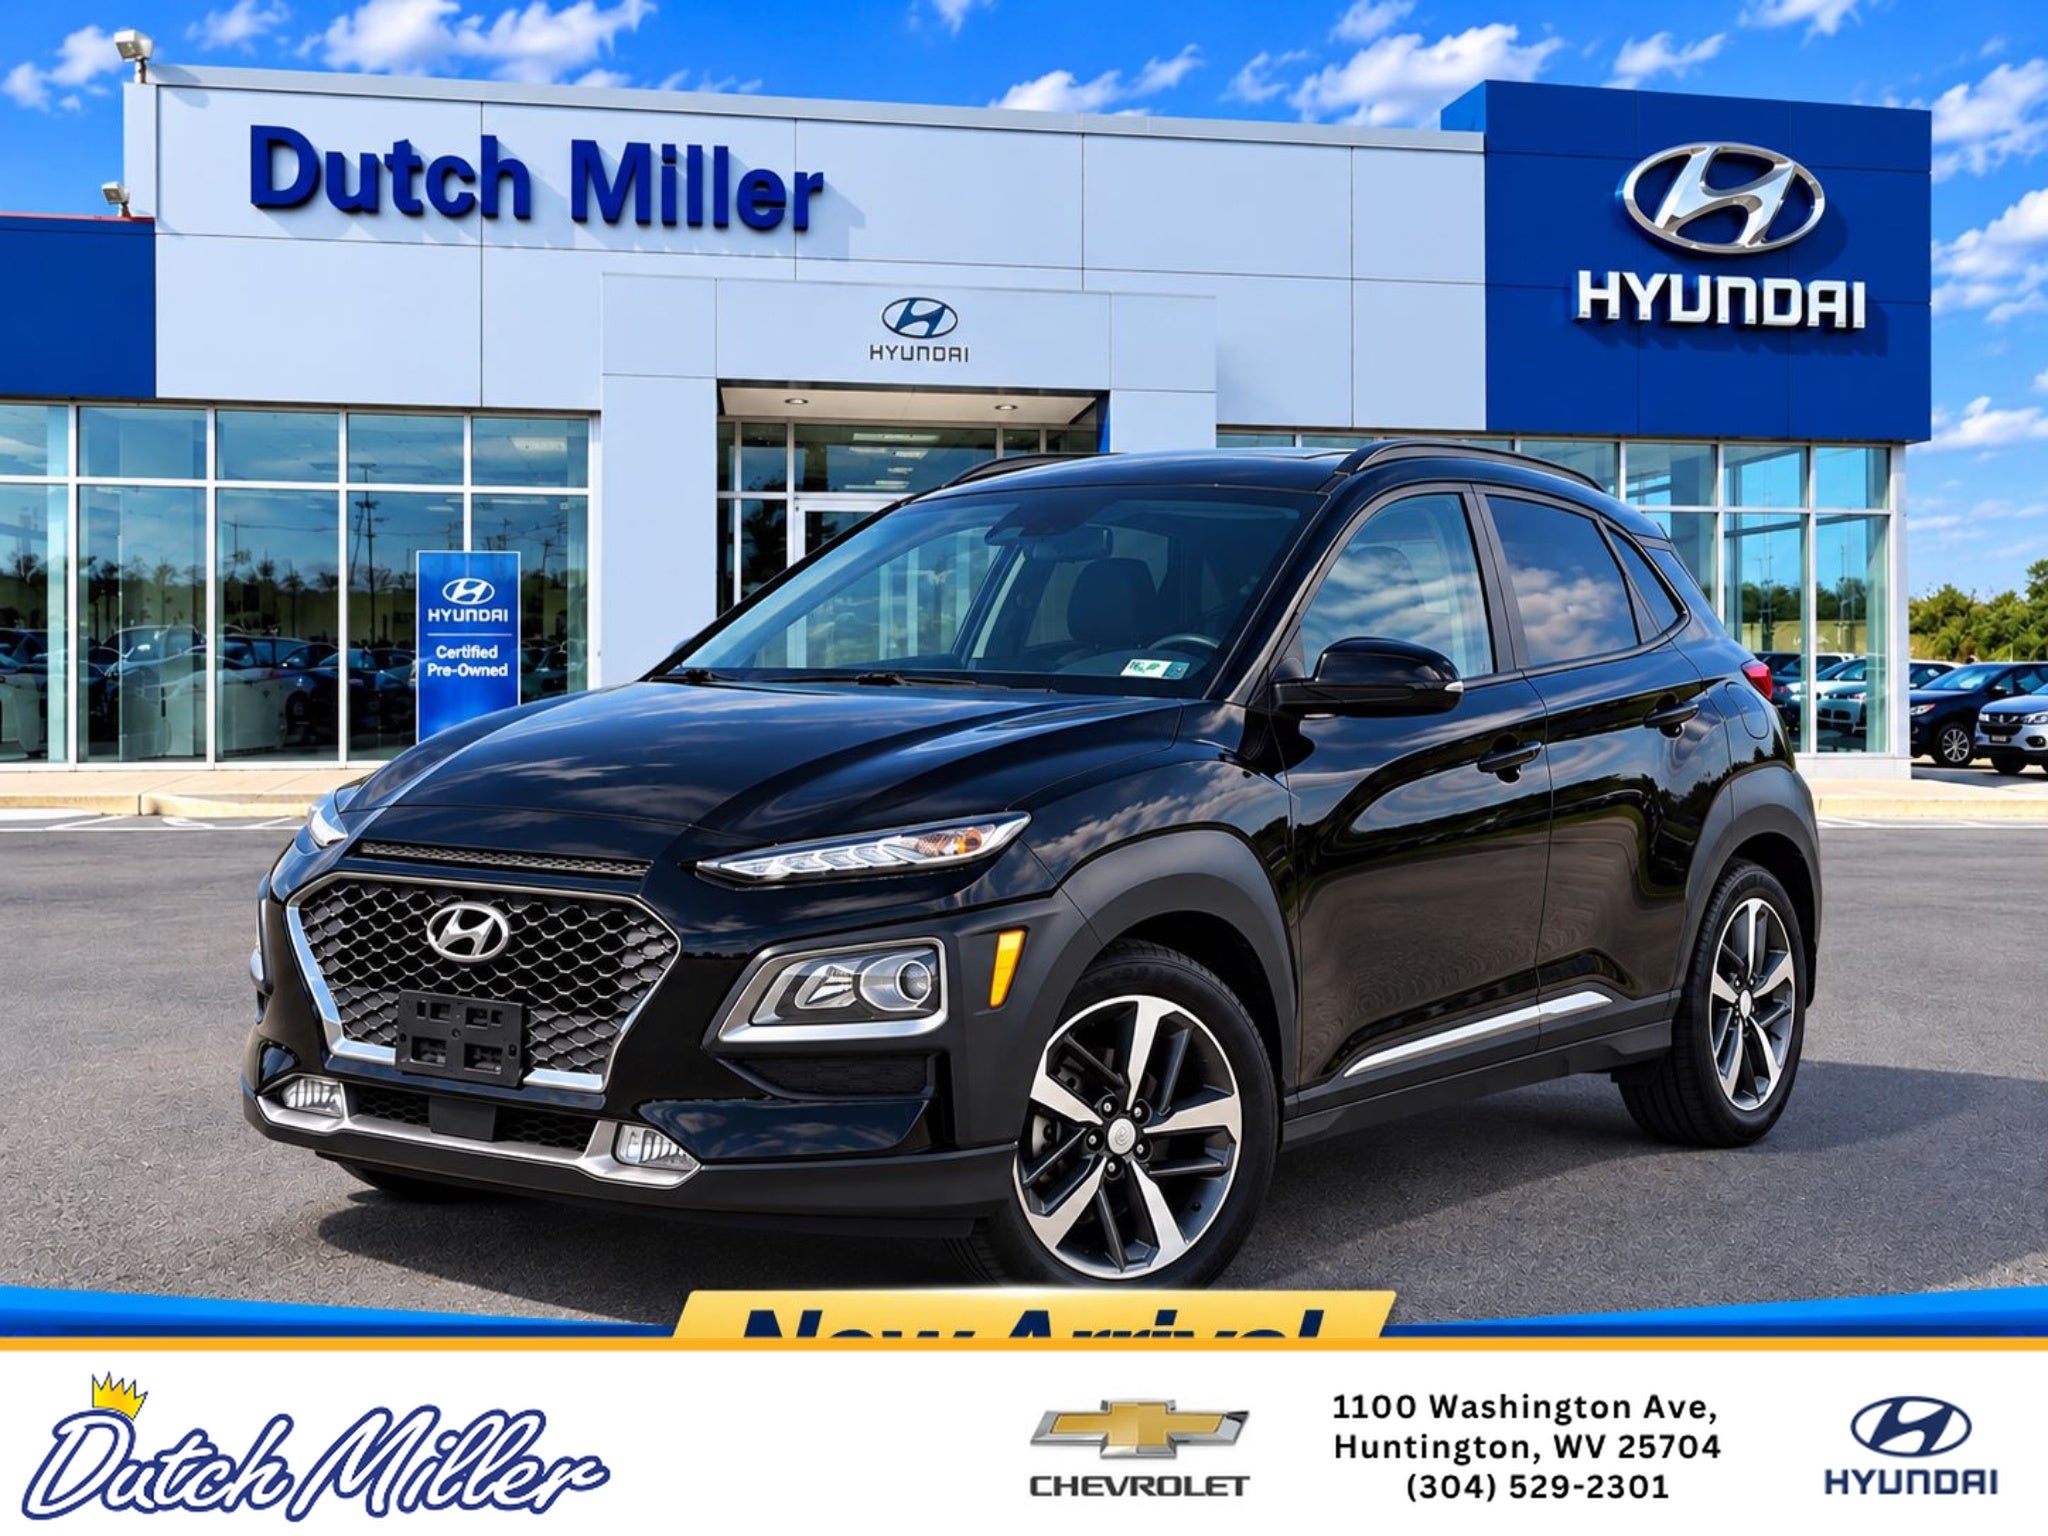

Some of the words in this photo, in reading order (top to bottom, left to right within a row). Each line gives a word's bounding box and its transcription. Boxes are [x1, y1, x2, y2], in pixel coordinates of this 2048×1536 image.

[251, 125, 531, 221] Dutch
[571, 139, 824, 233] Miller
[1575, 270, 1866, 329] HYUNDAI
[869, 344, 969, 363] HYUNDAI
[427, 608, 509, 622] HYUNDAI
[435, 644, 499, 659] Certified
[427, 662, 509, 677] Pre-Owned
